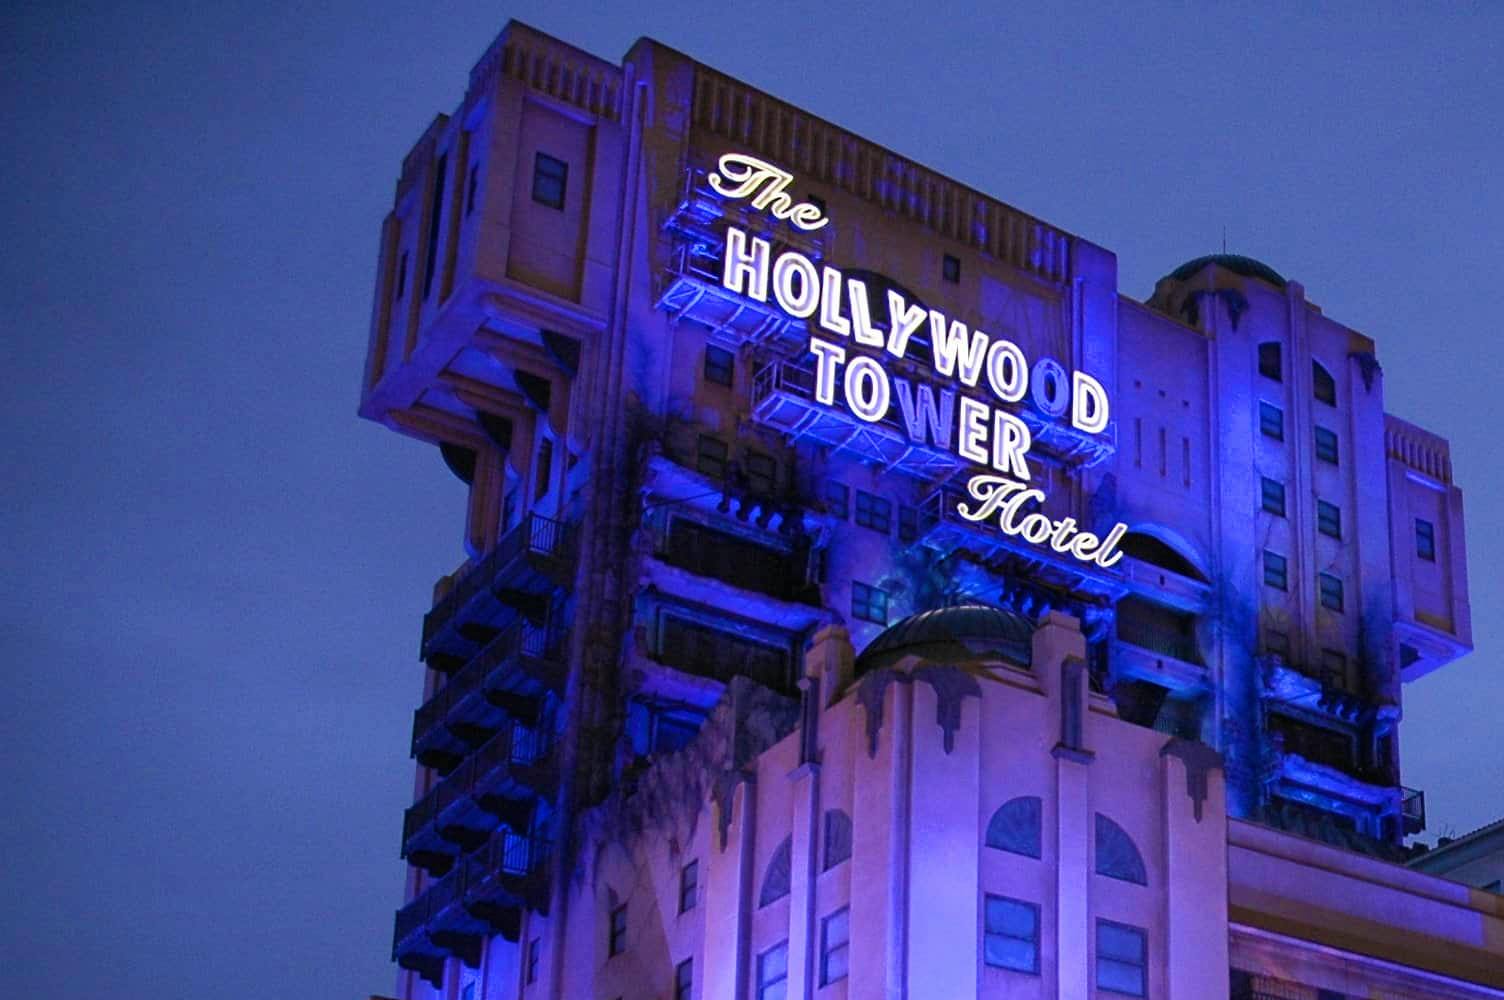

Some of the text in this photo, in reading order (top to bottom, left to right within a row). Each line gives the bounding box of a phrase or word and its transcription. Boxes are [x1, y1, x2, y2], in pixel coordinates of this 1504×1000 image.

[707, 152, 829, 231] The
[722, 226, 1110, 434] HOLLYWOOD
[810, 337, 1032, 480] TOWER
[957, 474, 1130, 568] Hotel
